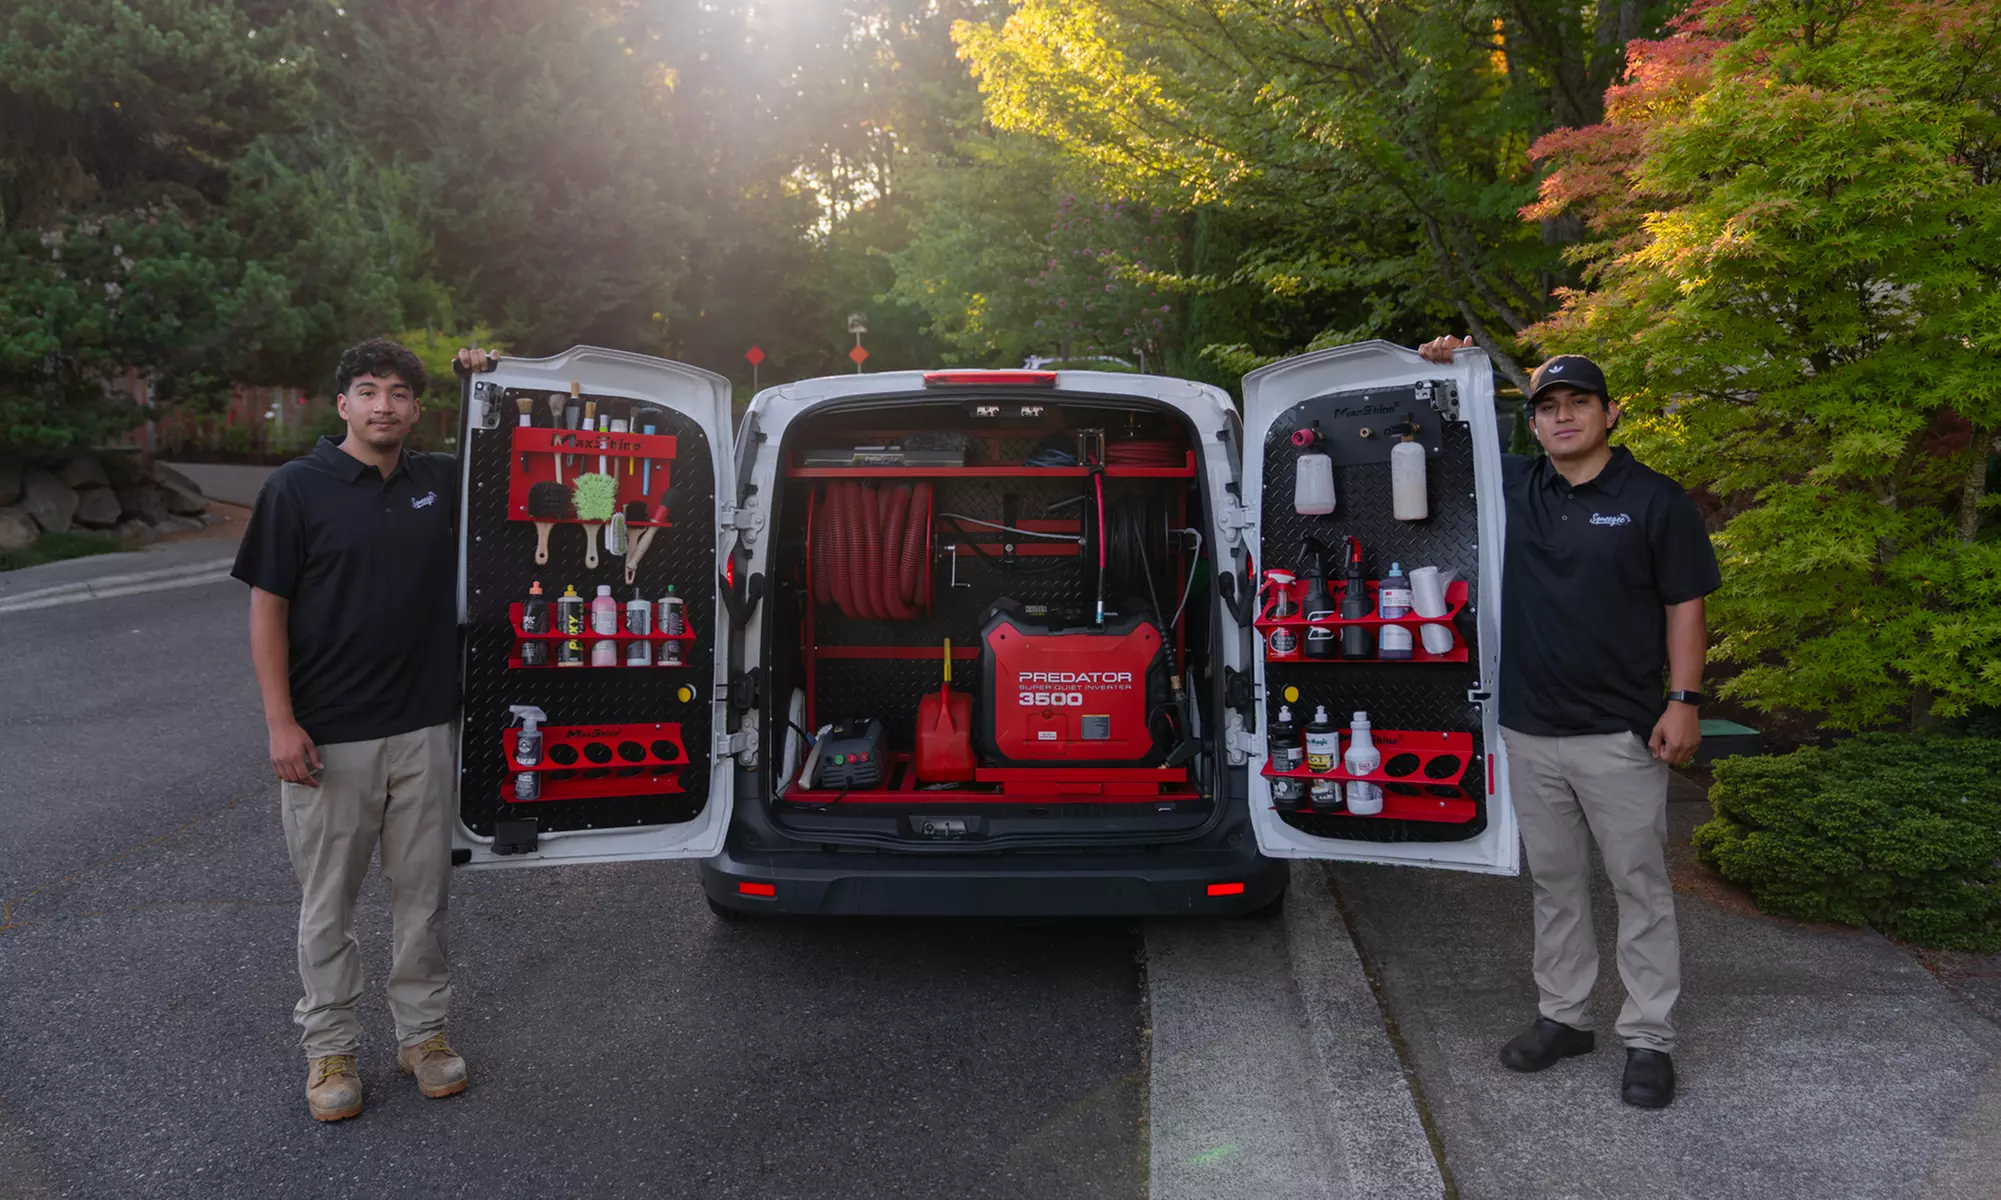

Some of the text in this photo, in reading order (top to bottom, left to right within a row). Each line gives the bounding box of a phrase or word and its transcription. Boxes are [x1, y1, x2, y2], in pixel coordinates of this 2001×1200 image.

[550, 433, 642, 451] MaxShine
[1018, 672, 1132, 683] PREDATOR
[1018, 692, 1083, 706] 3500
